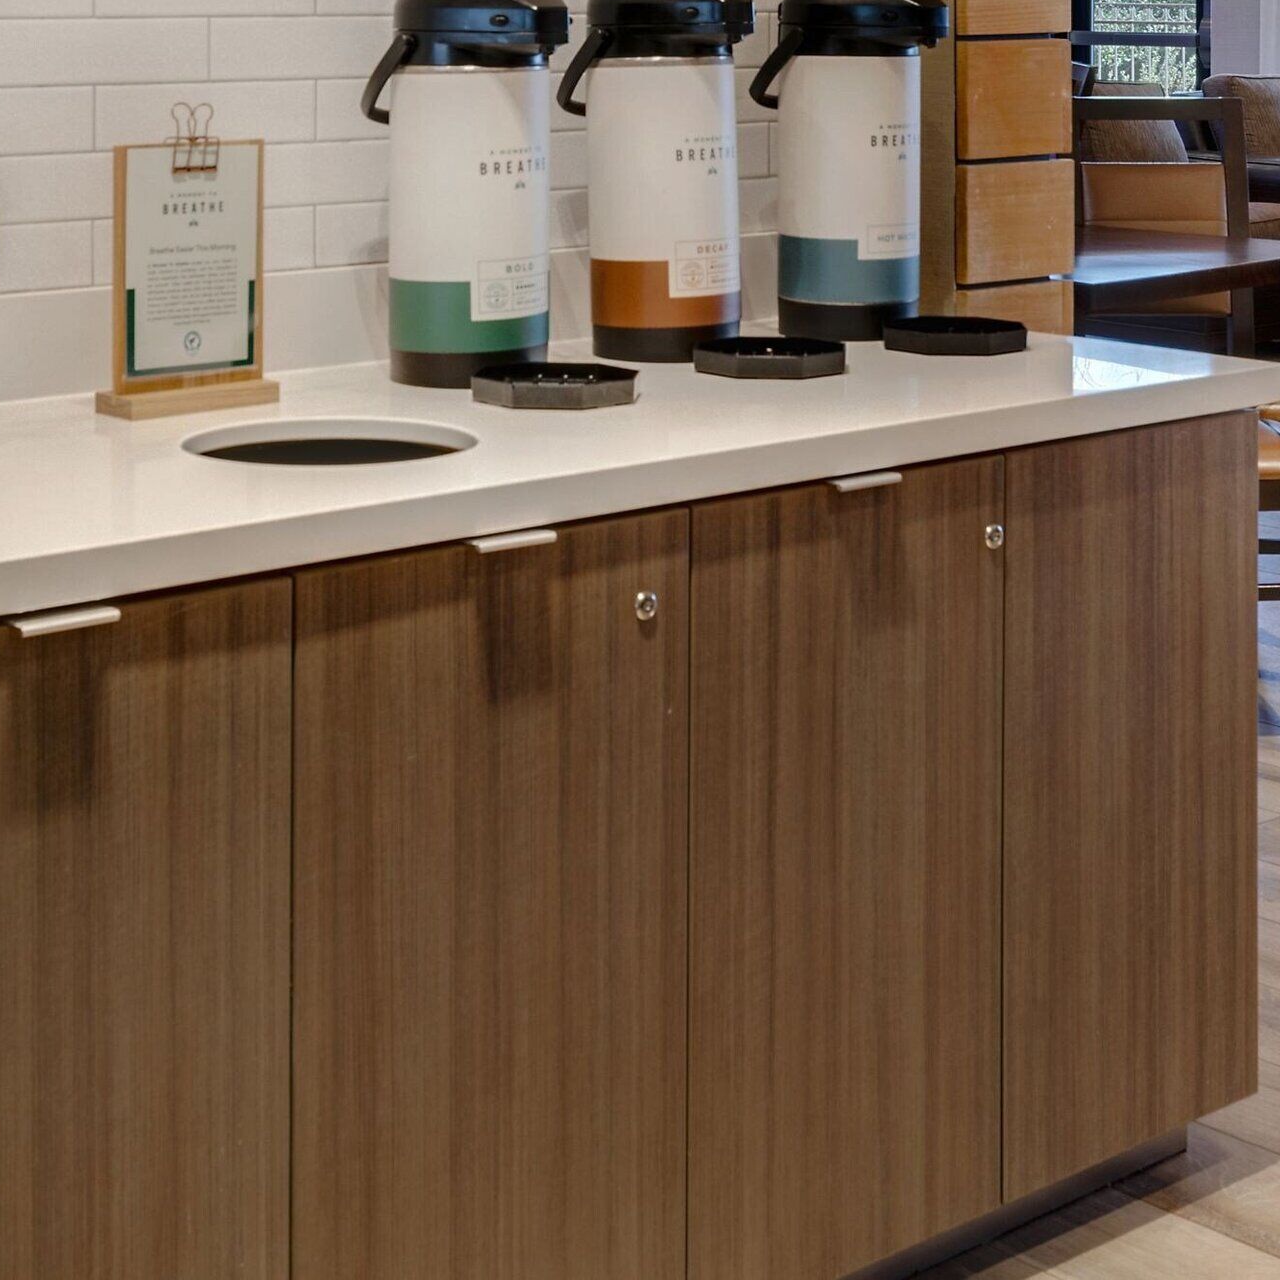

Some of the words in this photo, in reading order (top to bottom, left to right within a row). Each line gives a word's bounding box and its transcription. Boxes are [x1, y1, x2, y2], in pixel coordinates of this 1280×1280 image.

[479, 157, 546, 176] BREATHE
[162, 201, 224, 215] BREATHE
[505, 261, 534, 274] BOLD
